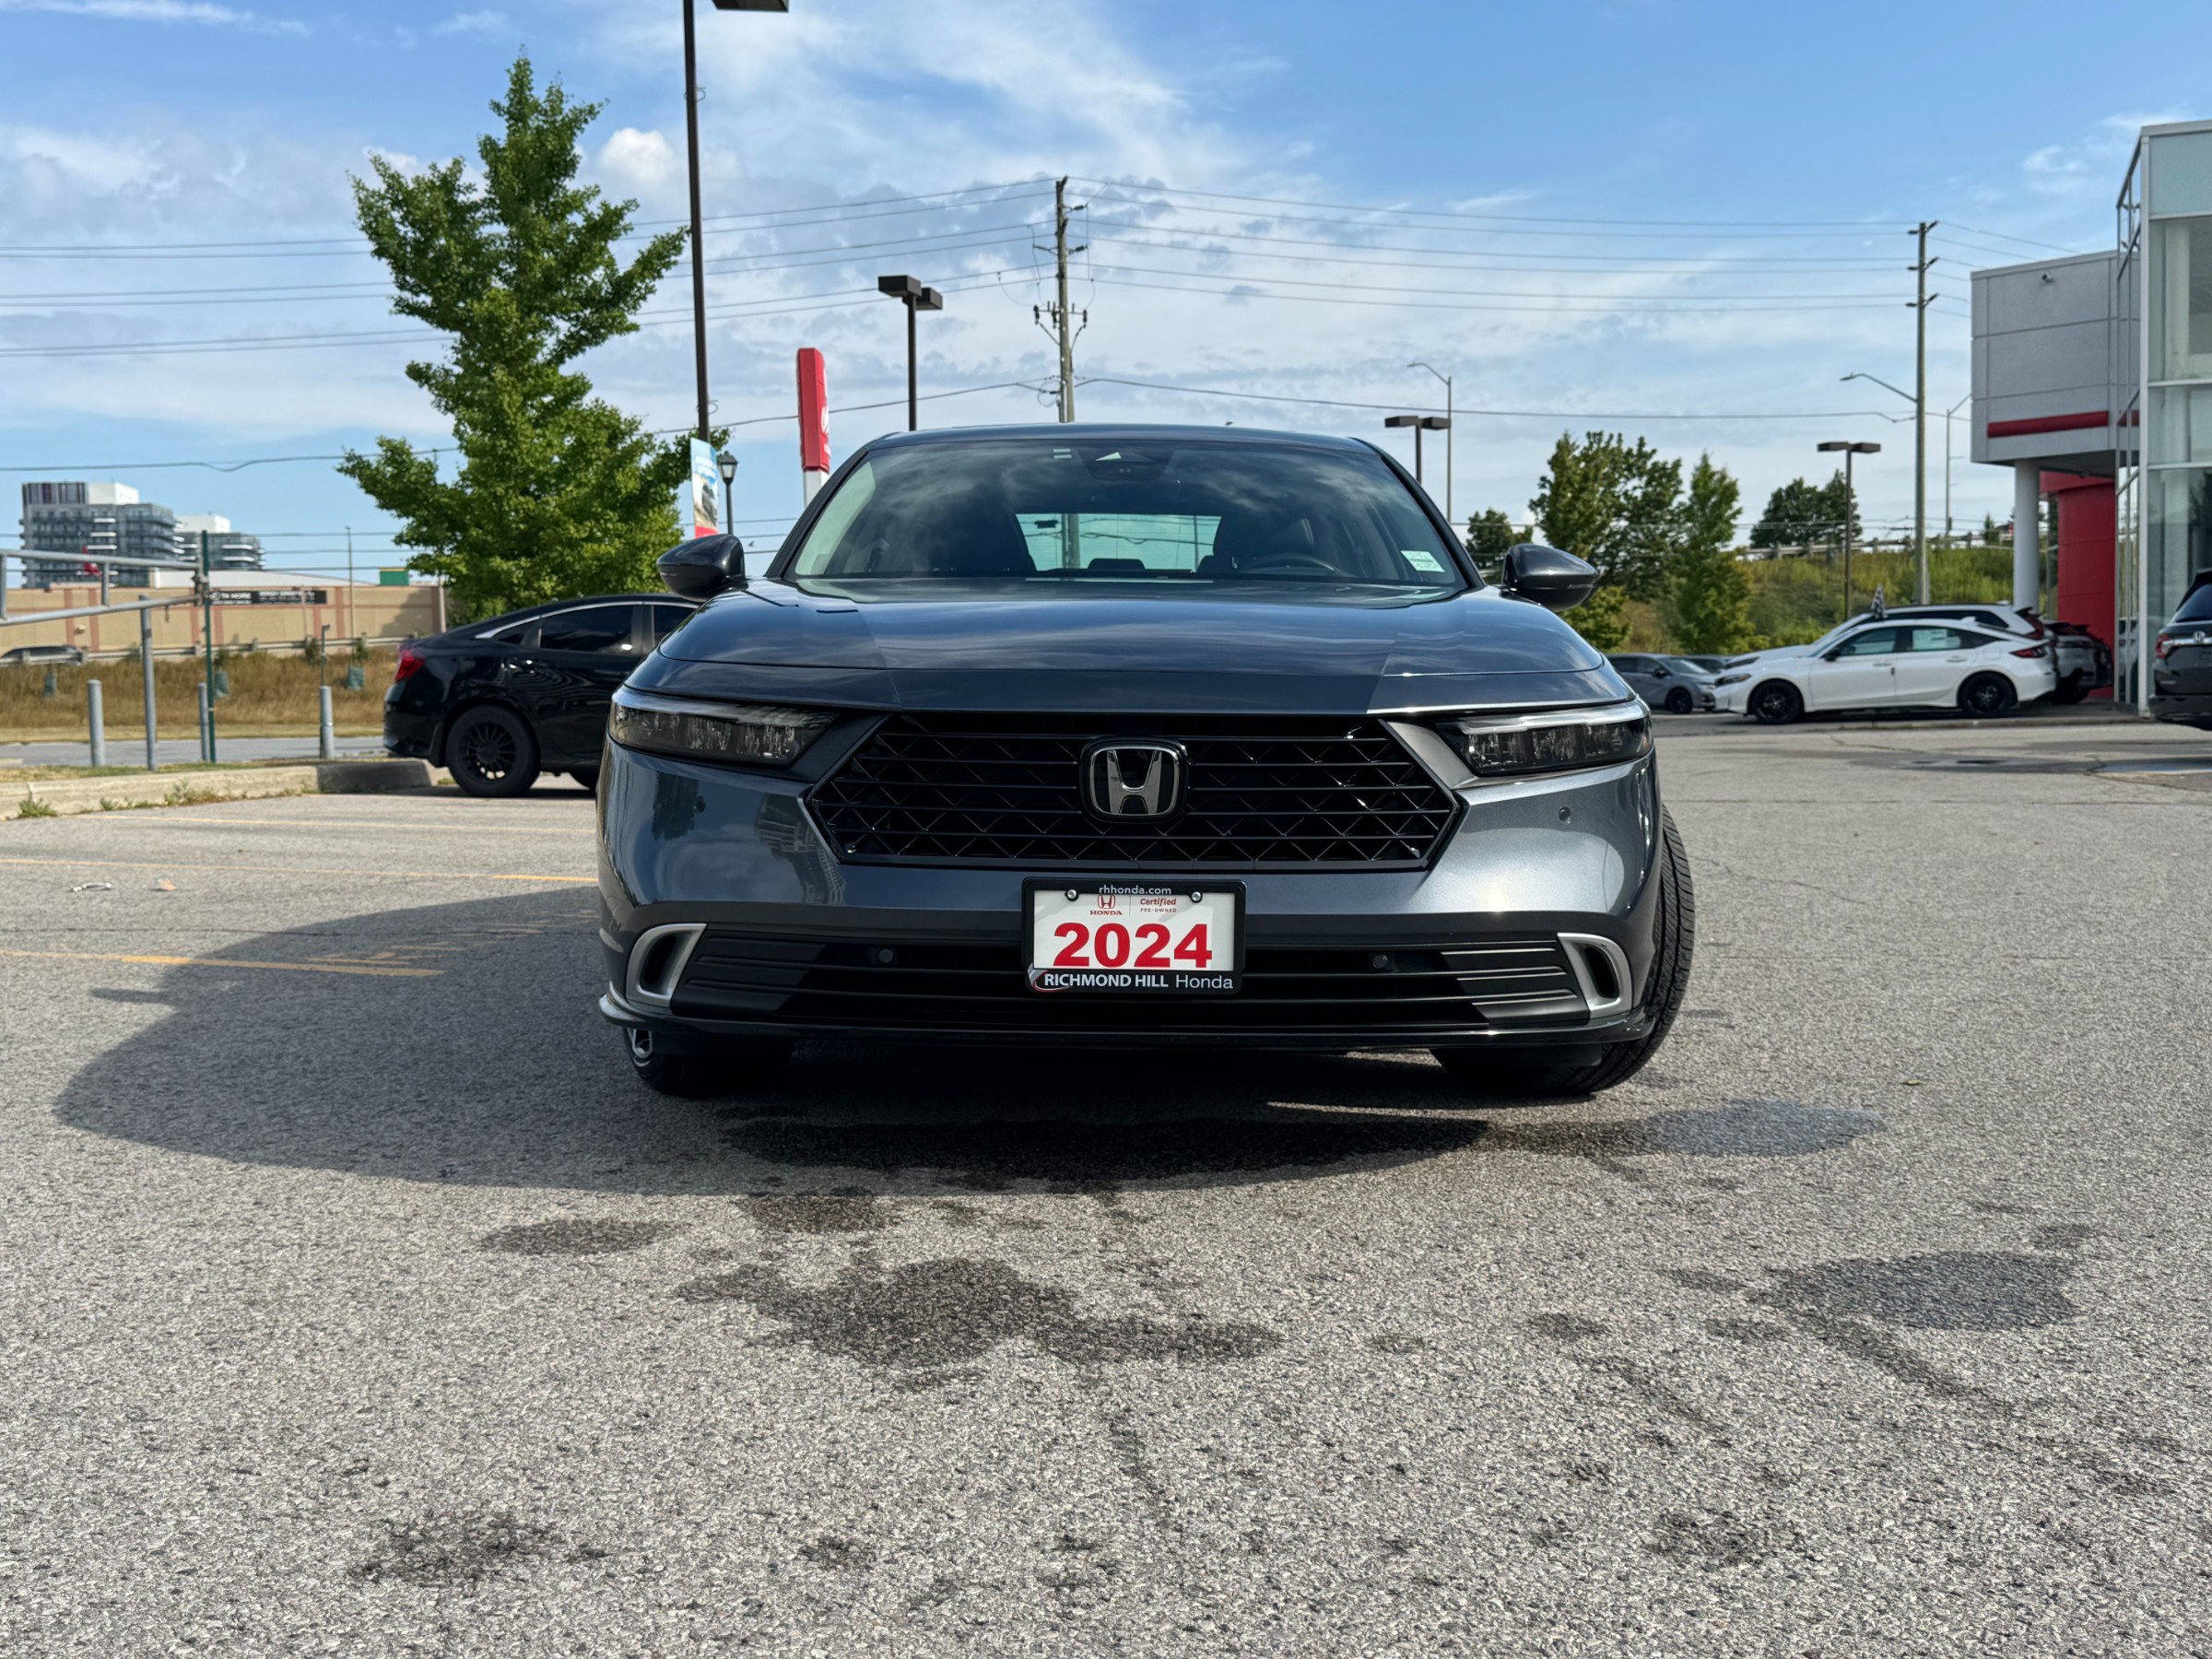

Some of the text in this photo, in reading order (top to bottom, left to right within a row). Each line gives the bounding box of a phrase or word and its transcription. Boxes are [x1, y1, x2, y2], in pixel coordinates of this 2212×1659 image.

[1099, 884, 1172, 895] rhhonda.com
[1140, 897, 1177, 906] Certified
[1053, 923, 1213, 968] 2024
[1044, 973, 1233, 989] RICHMOND HILL Honda
